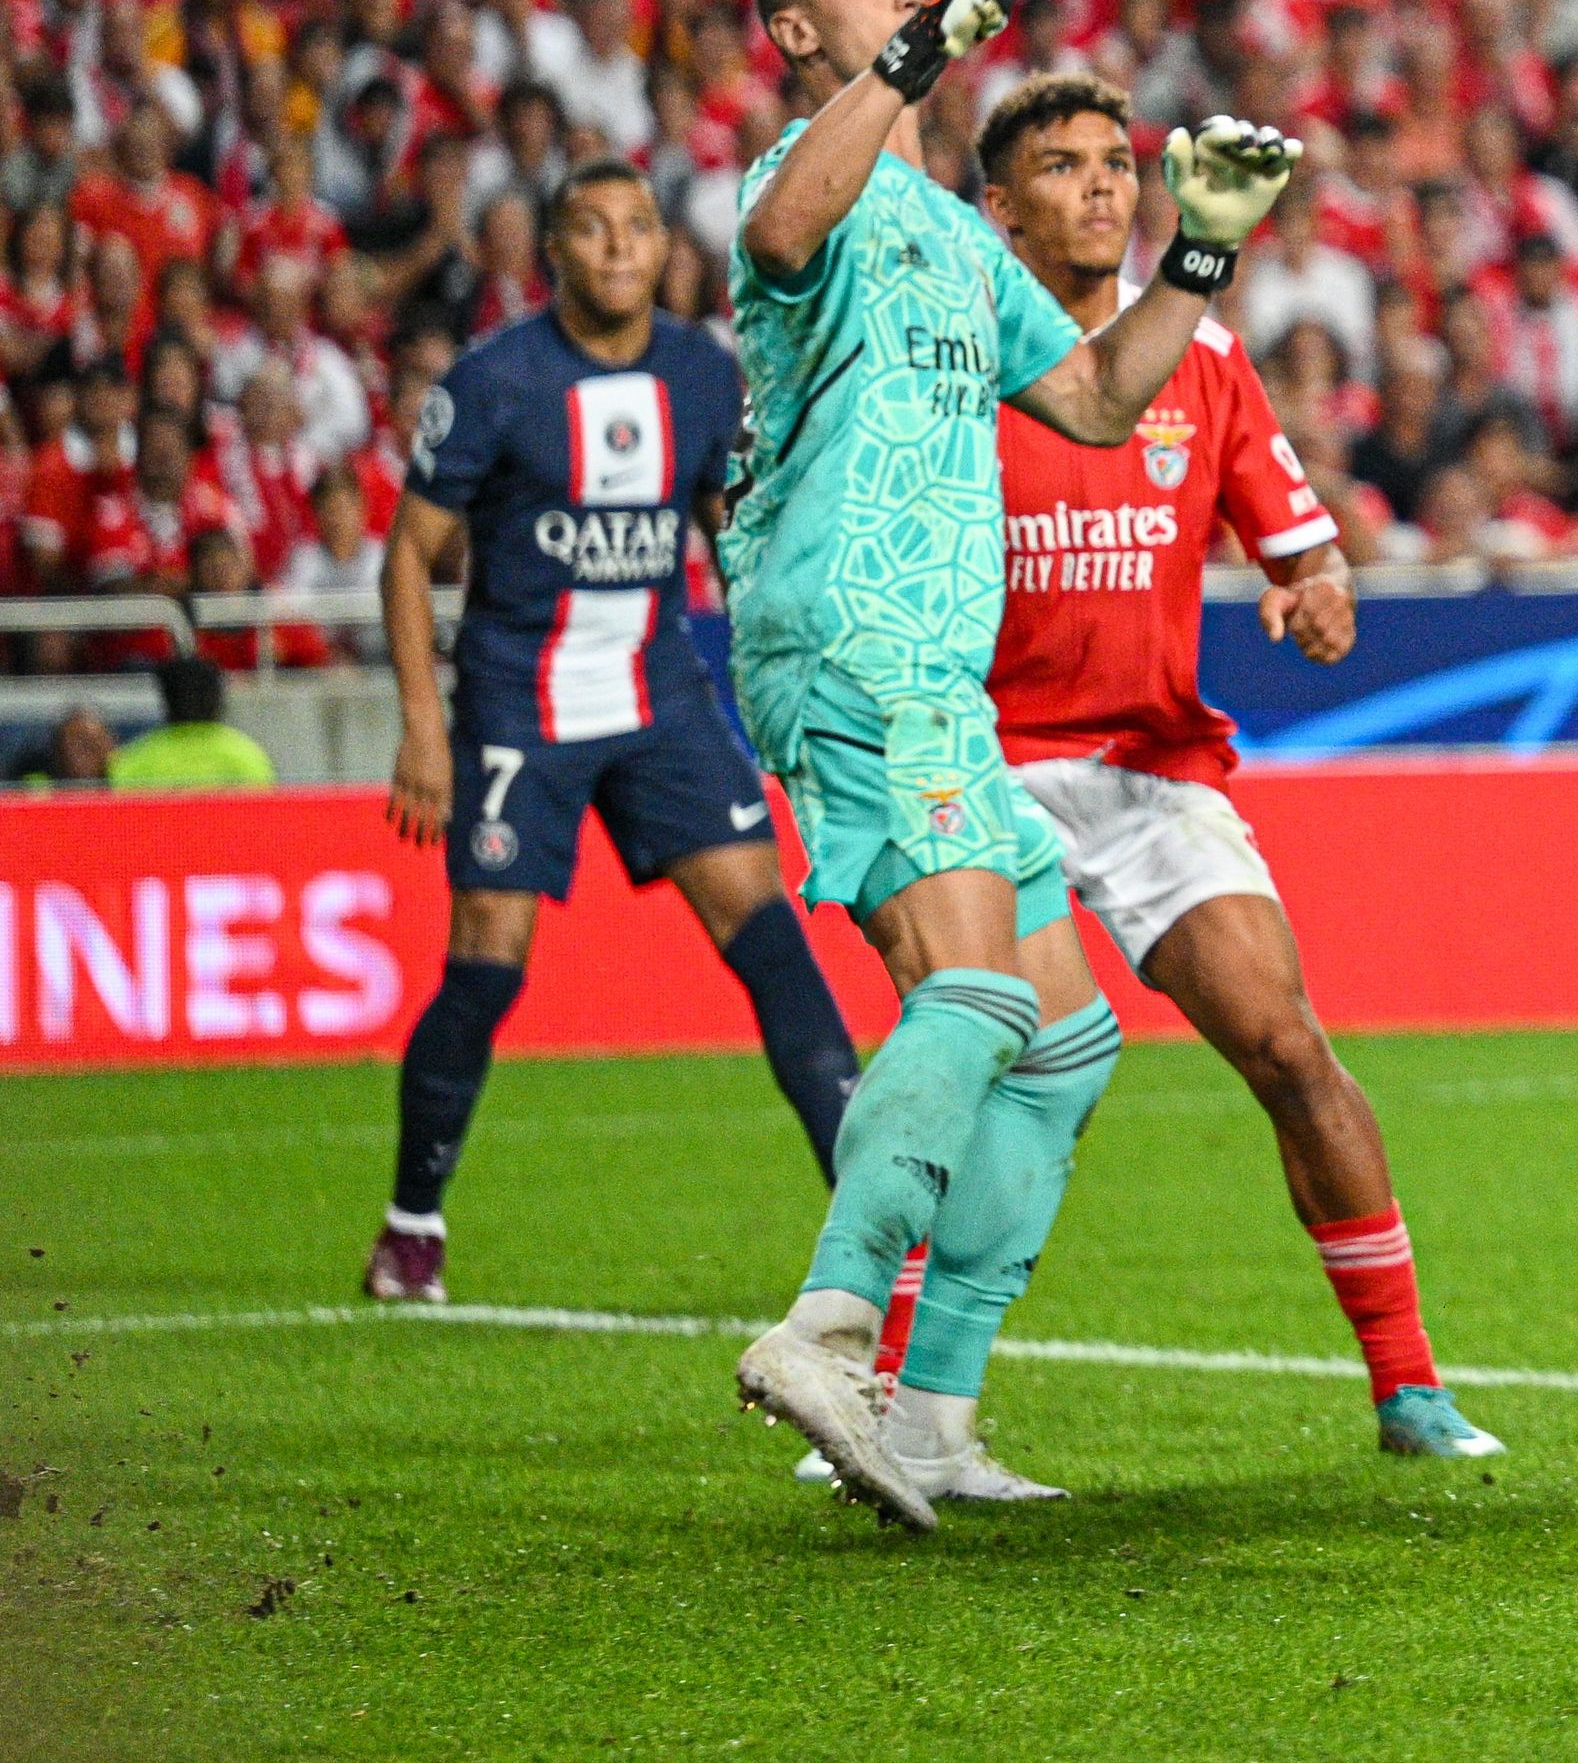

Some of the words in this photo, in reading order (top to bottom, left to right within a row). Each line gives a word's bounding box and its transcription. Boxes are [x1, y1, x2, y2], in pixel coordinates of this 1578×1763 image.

[906, 325, 990, 373] Emi
[534, 509, 680, 566] QATAR
[1003, 500, 1178, 553] mirates
[1011, 552, 1052, 593] FLY
[1061, 551, 1154, 592] BETTER
[481, 745, 525, 822] 7
